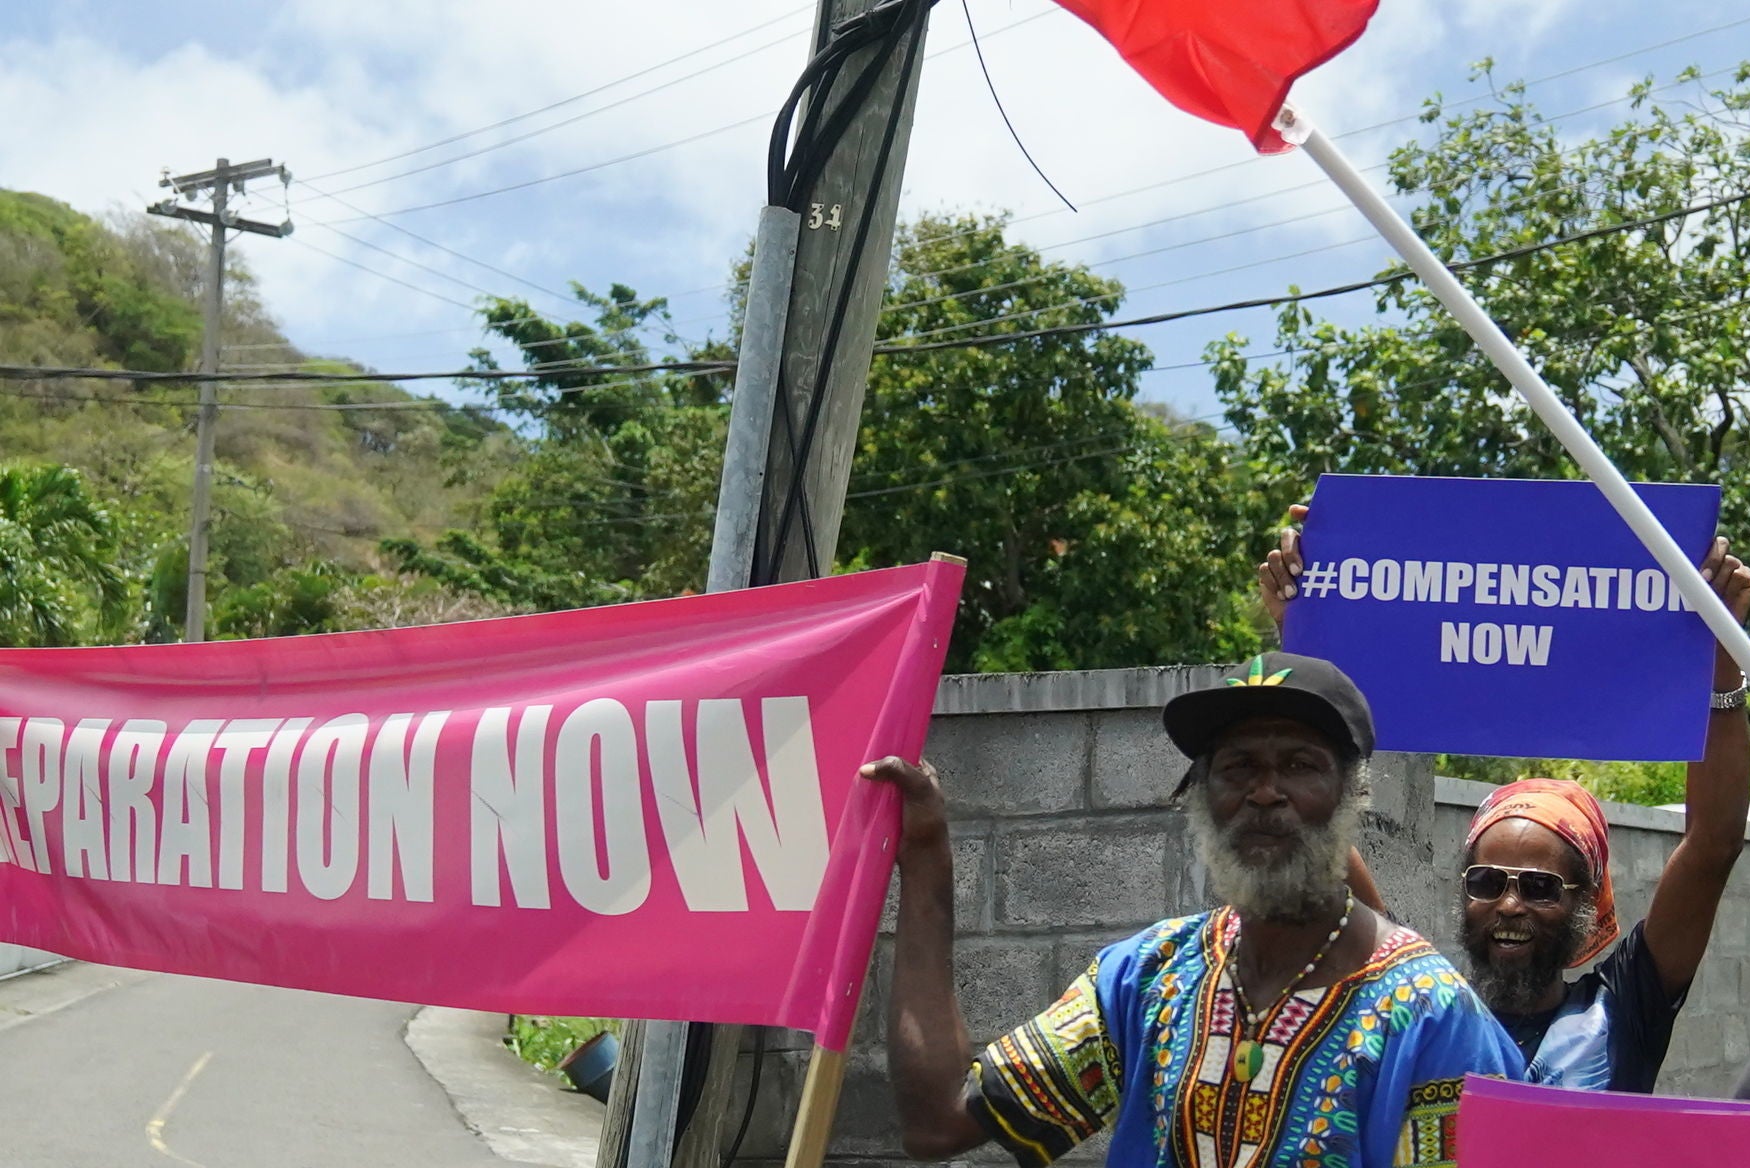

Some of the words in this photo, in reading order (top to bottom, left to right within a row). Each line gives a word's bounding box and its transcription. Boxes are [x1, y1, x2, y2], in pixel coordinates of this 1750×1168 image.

[1440, 621, 1553, 666] NOW
[0, 711, 453, 903] EPARATION
[470, 695, 830, 916] NOW
